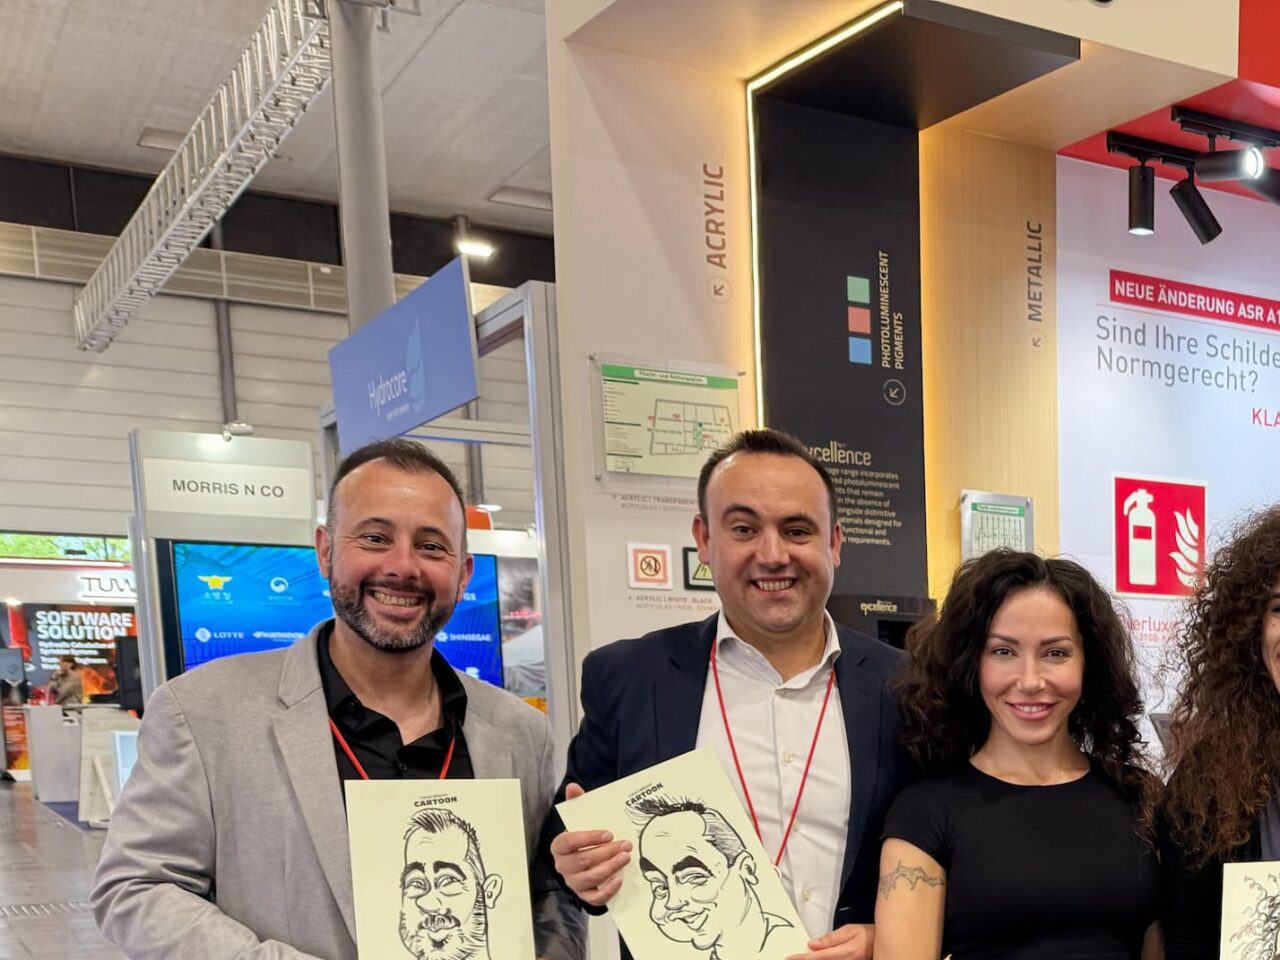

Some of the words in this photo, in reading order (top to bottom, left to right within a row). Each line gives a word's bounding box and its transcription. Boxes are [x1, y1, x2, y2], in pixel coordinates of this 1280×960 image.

[703, 163, 727, 270] ACRYLIC
[1027, 221, 1042, 322] METALLIC
[879, 251, 891, 368] PHOTOLUMINESCENT
[1115, 280, 1154, 301] NEUE
[1158, 284, 1235, 315] ÄNDERUNG
[1238, 306, 1264, 322] ASR
[894, 313, 904, 369] PIGMENTS
[1096, 316, 1146, 347] Sind
[1155, 325, 1199, 355] Ihre
[1097, 346, 1259, 393] Normgerecht?
[172, 479, 239, 495] MORRIS
[244, 484, 255, 496] N
[260, 485, 284, 498] CO
[35, 611, 133, 627] SOFTWARE
[37, 625, 128, 640] SOLUTION
[213, 631, 244, 639] LOTTE
[414, 796, 457, 807] CARTOON
[625, 782, 663, 806] CARTOON
